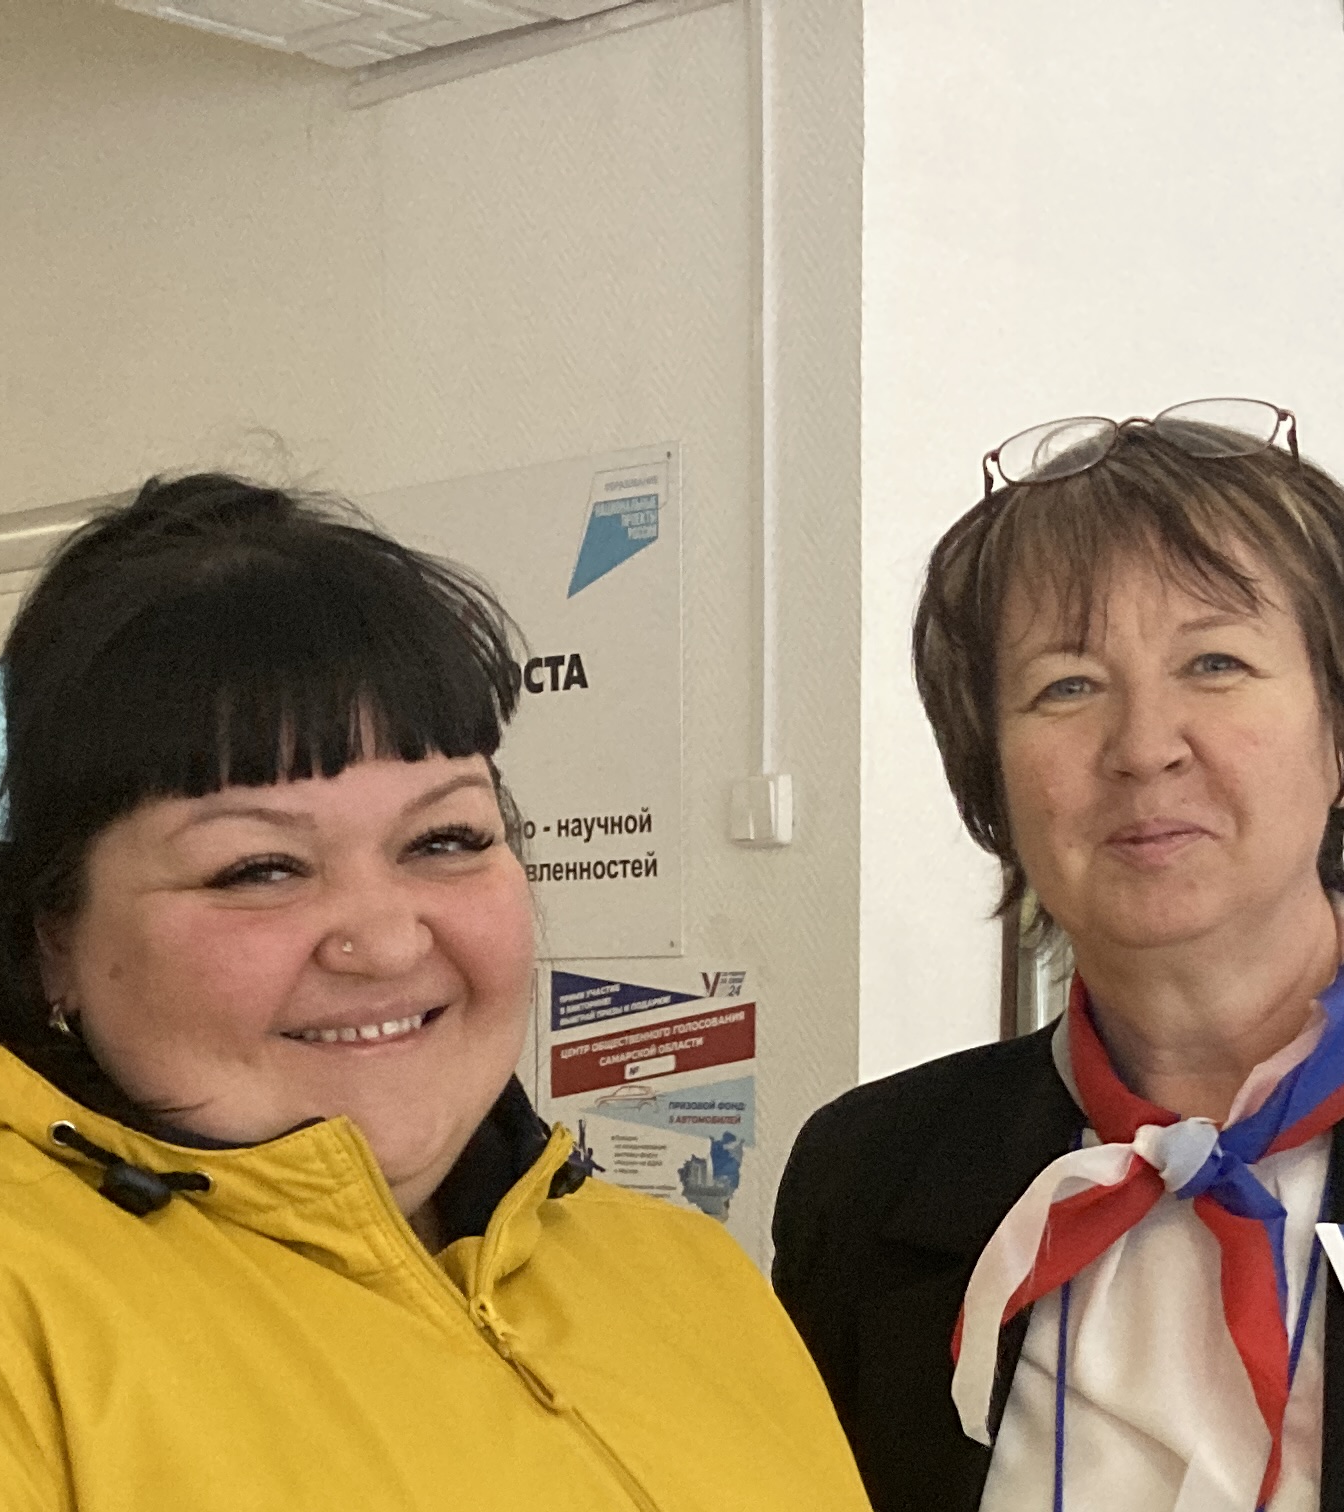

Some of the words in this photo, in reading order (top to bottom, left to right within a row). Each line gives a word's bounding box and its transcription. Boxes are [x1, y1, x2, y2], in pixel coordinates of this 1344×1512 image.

[513, 653, 589, 695] СТА
[557, 806, 652, 844] научной
[524, 850, 658, 882] вленностей
[728, 984, 743, 997] 24
[560, 1043, 590, 1059] ЦЕНТР
[591, 1026, 671, 1052] ОБЩЕСТВЕННОГО
[672, 1011, 746, 1037] ГОЛОСОВАНИЯ
[599, 1045, 657, 1066] САМАРСКОЙ
[657, 1036, 704, 1056] ОБЛАСТИ
[668, 1100, 716, 1110] ПРИЗОВОЙ
[675, 1115, 742, 1124] АВТОМОБИЛЕЙ
